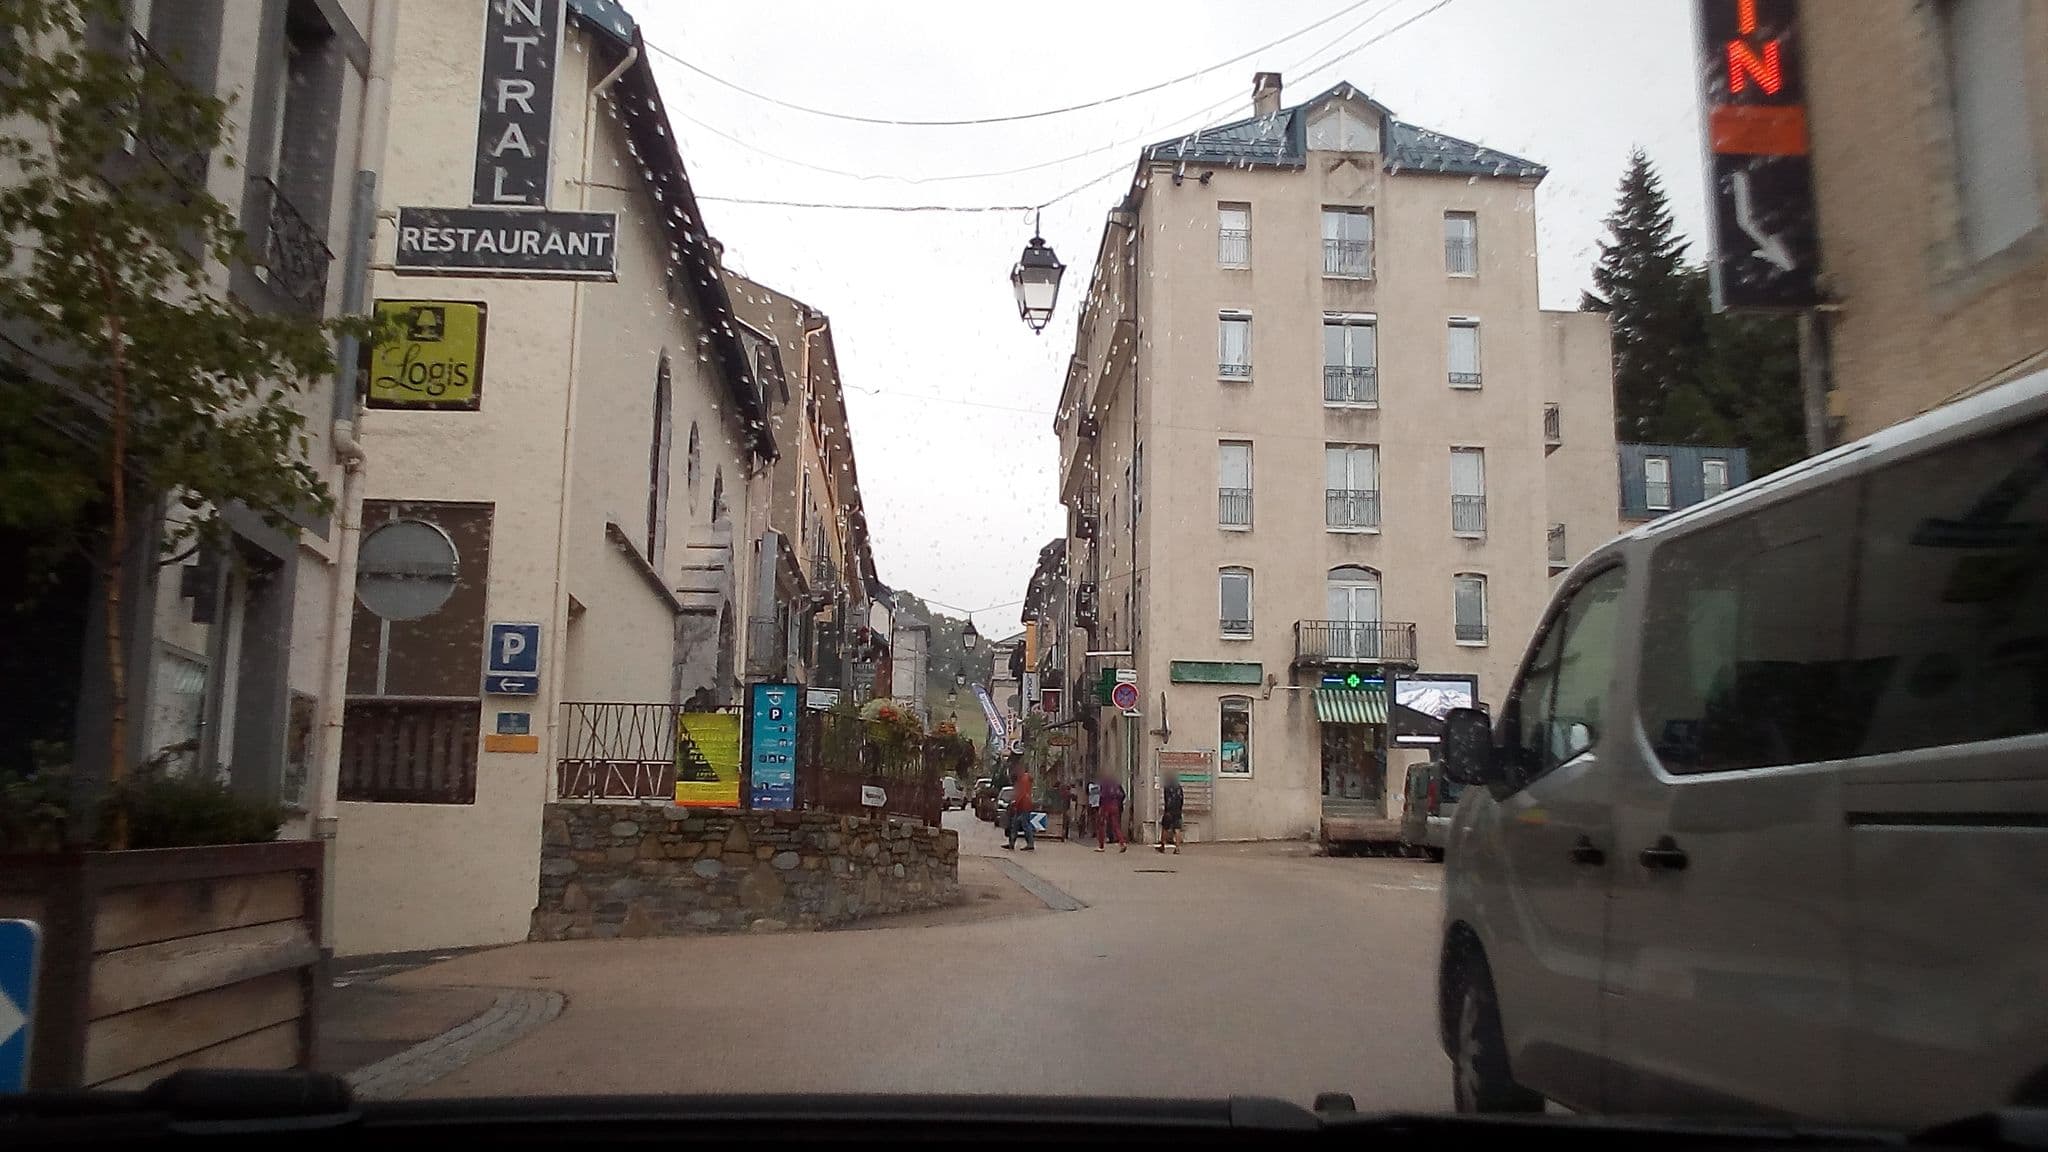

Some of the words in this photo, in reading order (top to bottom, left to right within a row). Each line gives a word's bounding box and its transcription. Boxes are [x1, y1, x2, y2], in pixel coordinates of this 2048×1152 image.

[401, 227, 610, 257] RESTAURANT
[376, 343, 469, 396] Logis
[502, 632, 526, 664] P
[772, 709, 780, 719] P
